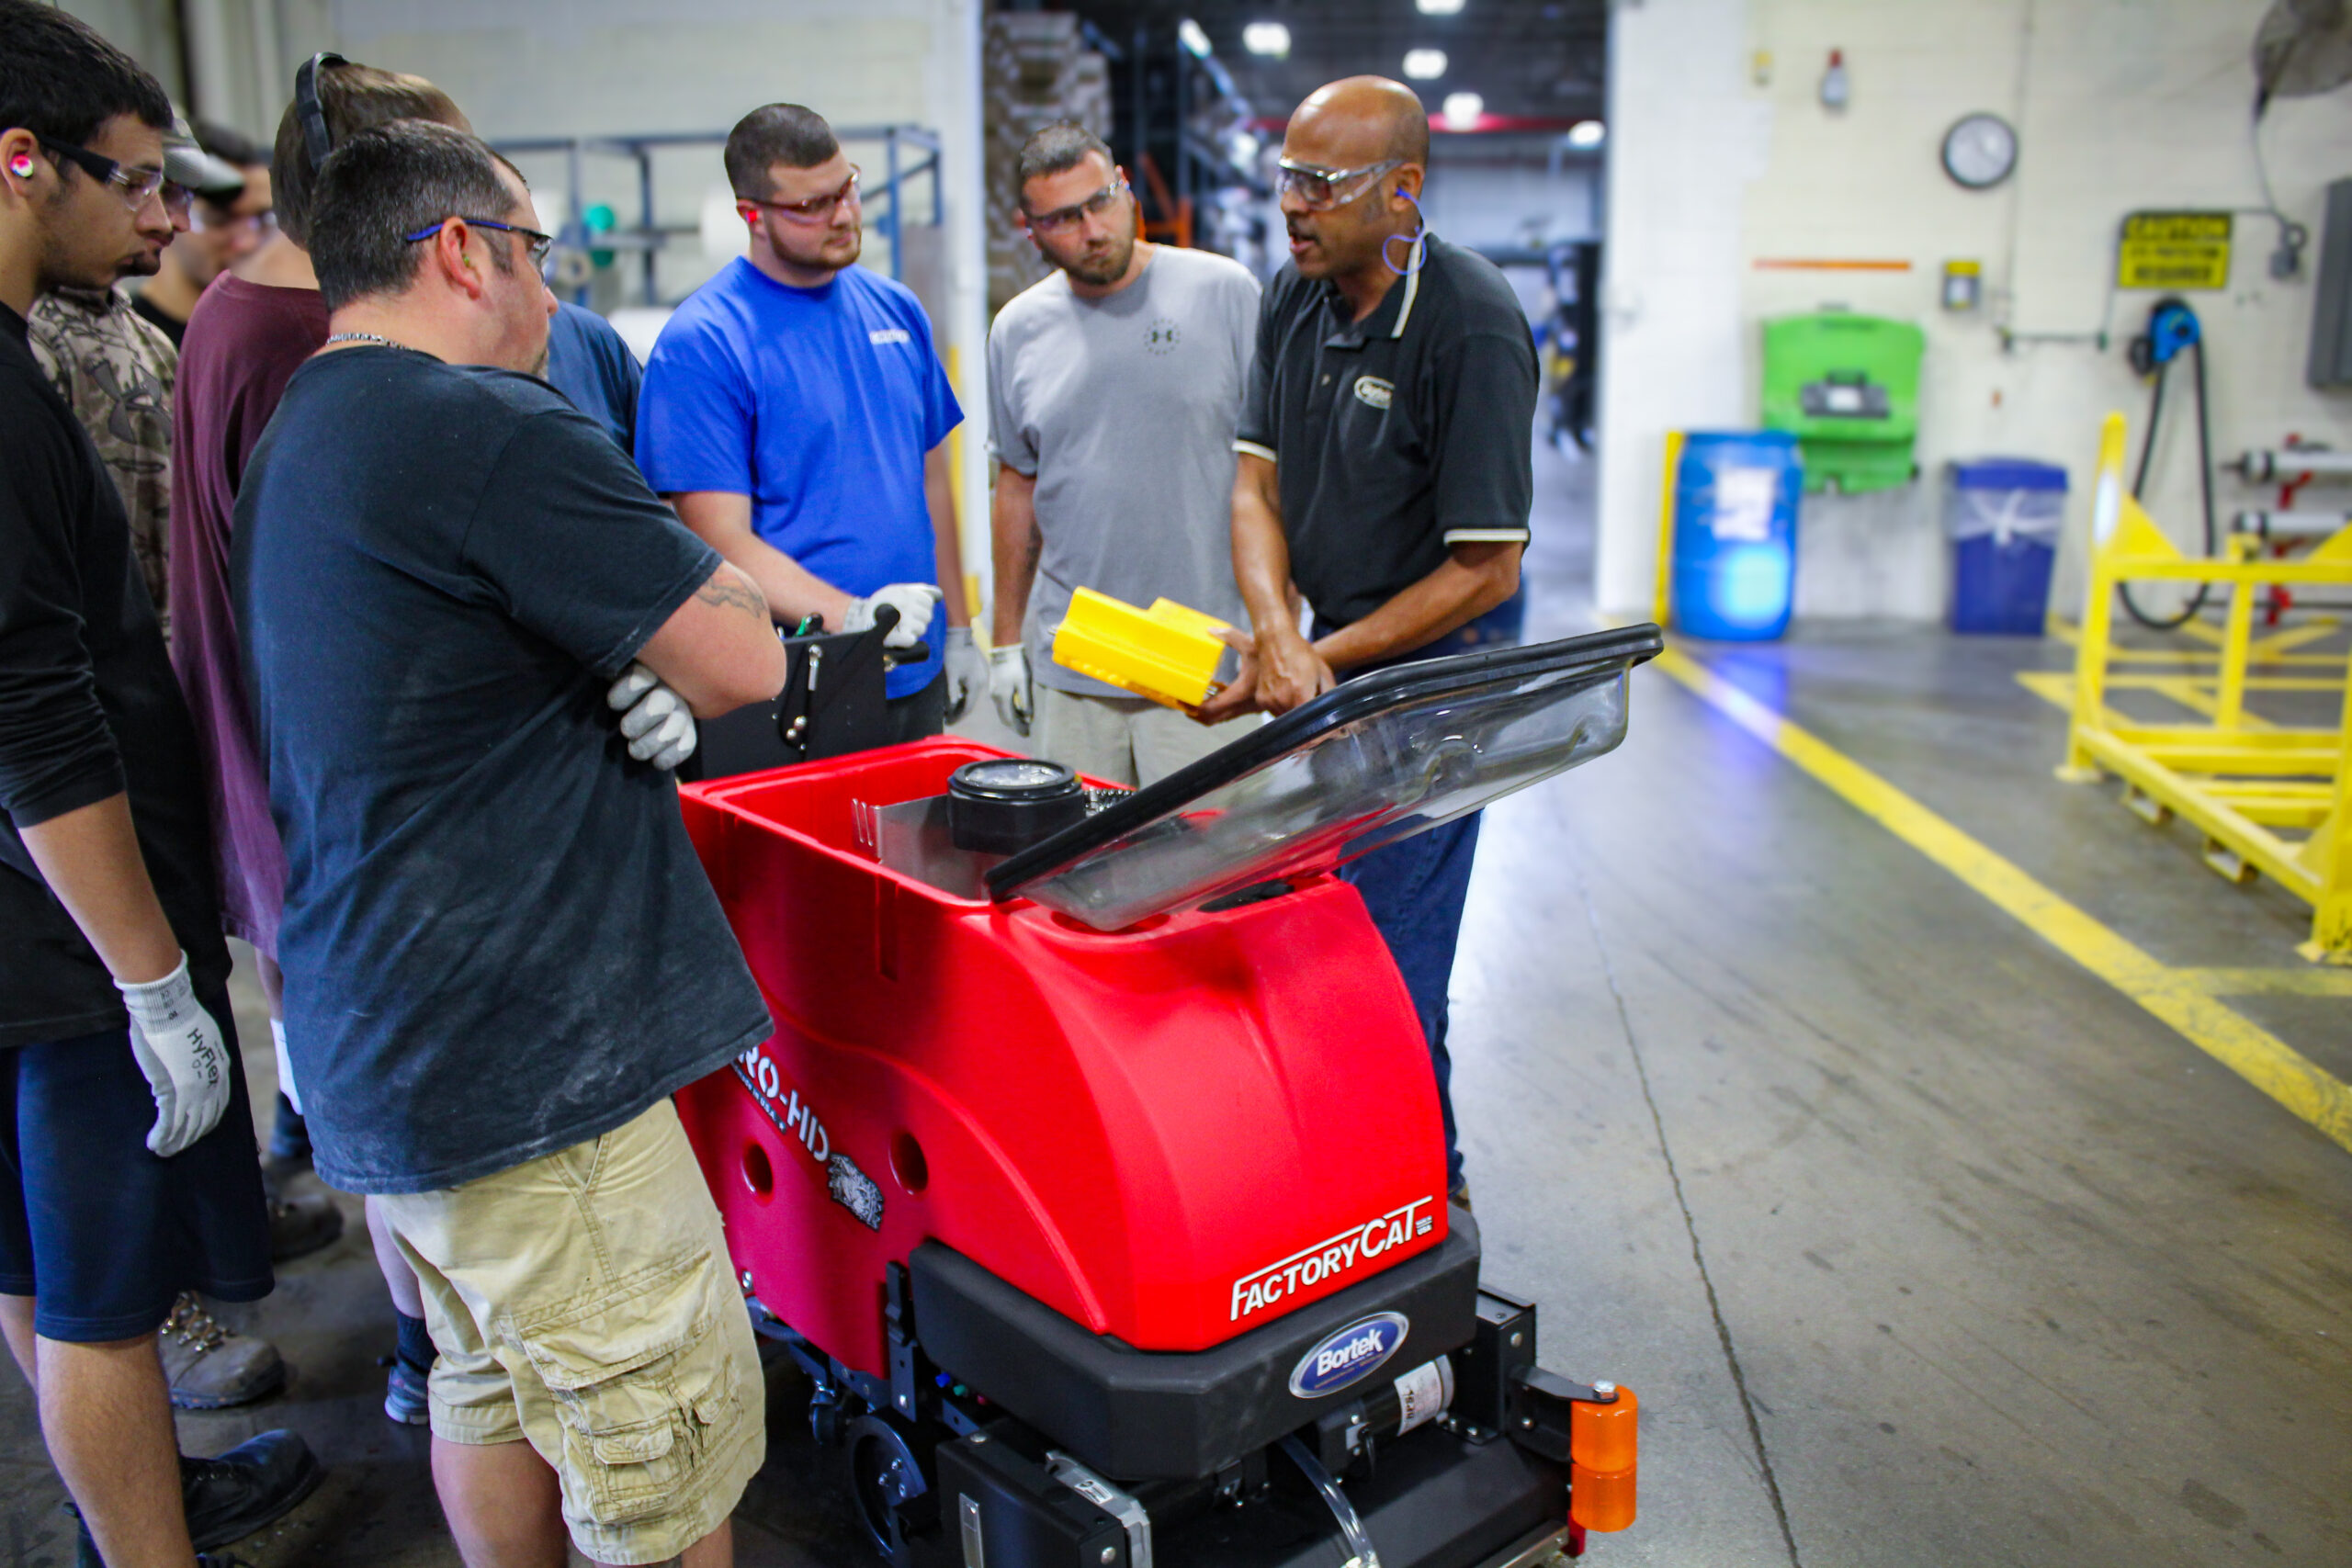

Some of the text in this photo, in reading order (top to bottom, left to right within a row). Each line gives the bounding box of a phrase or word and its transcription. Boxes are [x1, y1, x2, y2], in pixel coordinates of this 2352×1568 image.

[187, 1028, 220, 1089] HyFlex
[738, 1046, 831, 1163] RO-HD
[1316, 1328, 1385, 1377] Bortek
